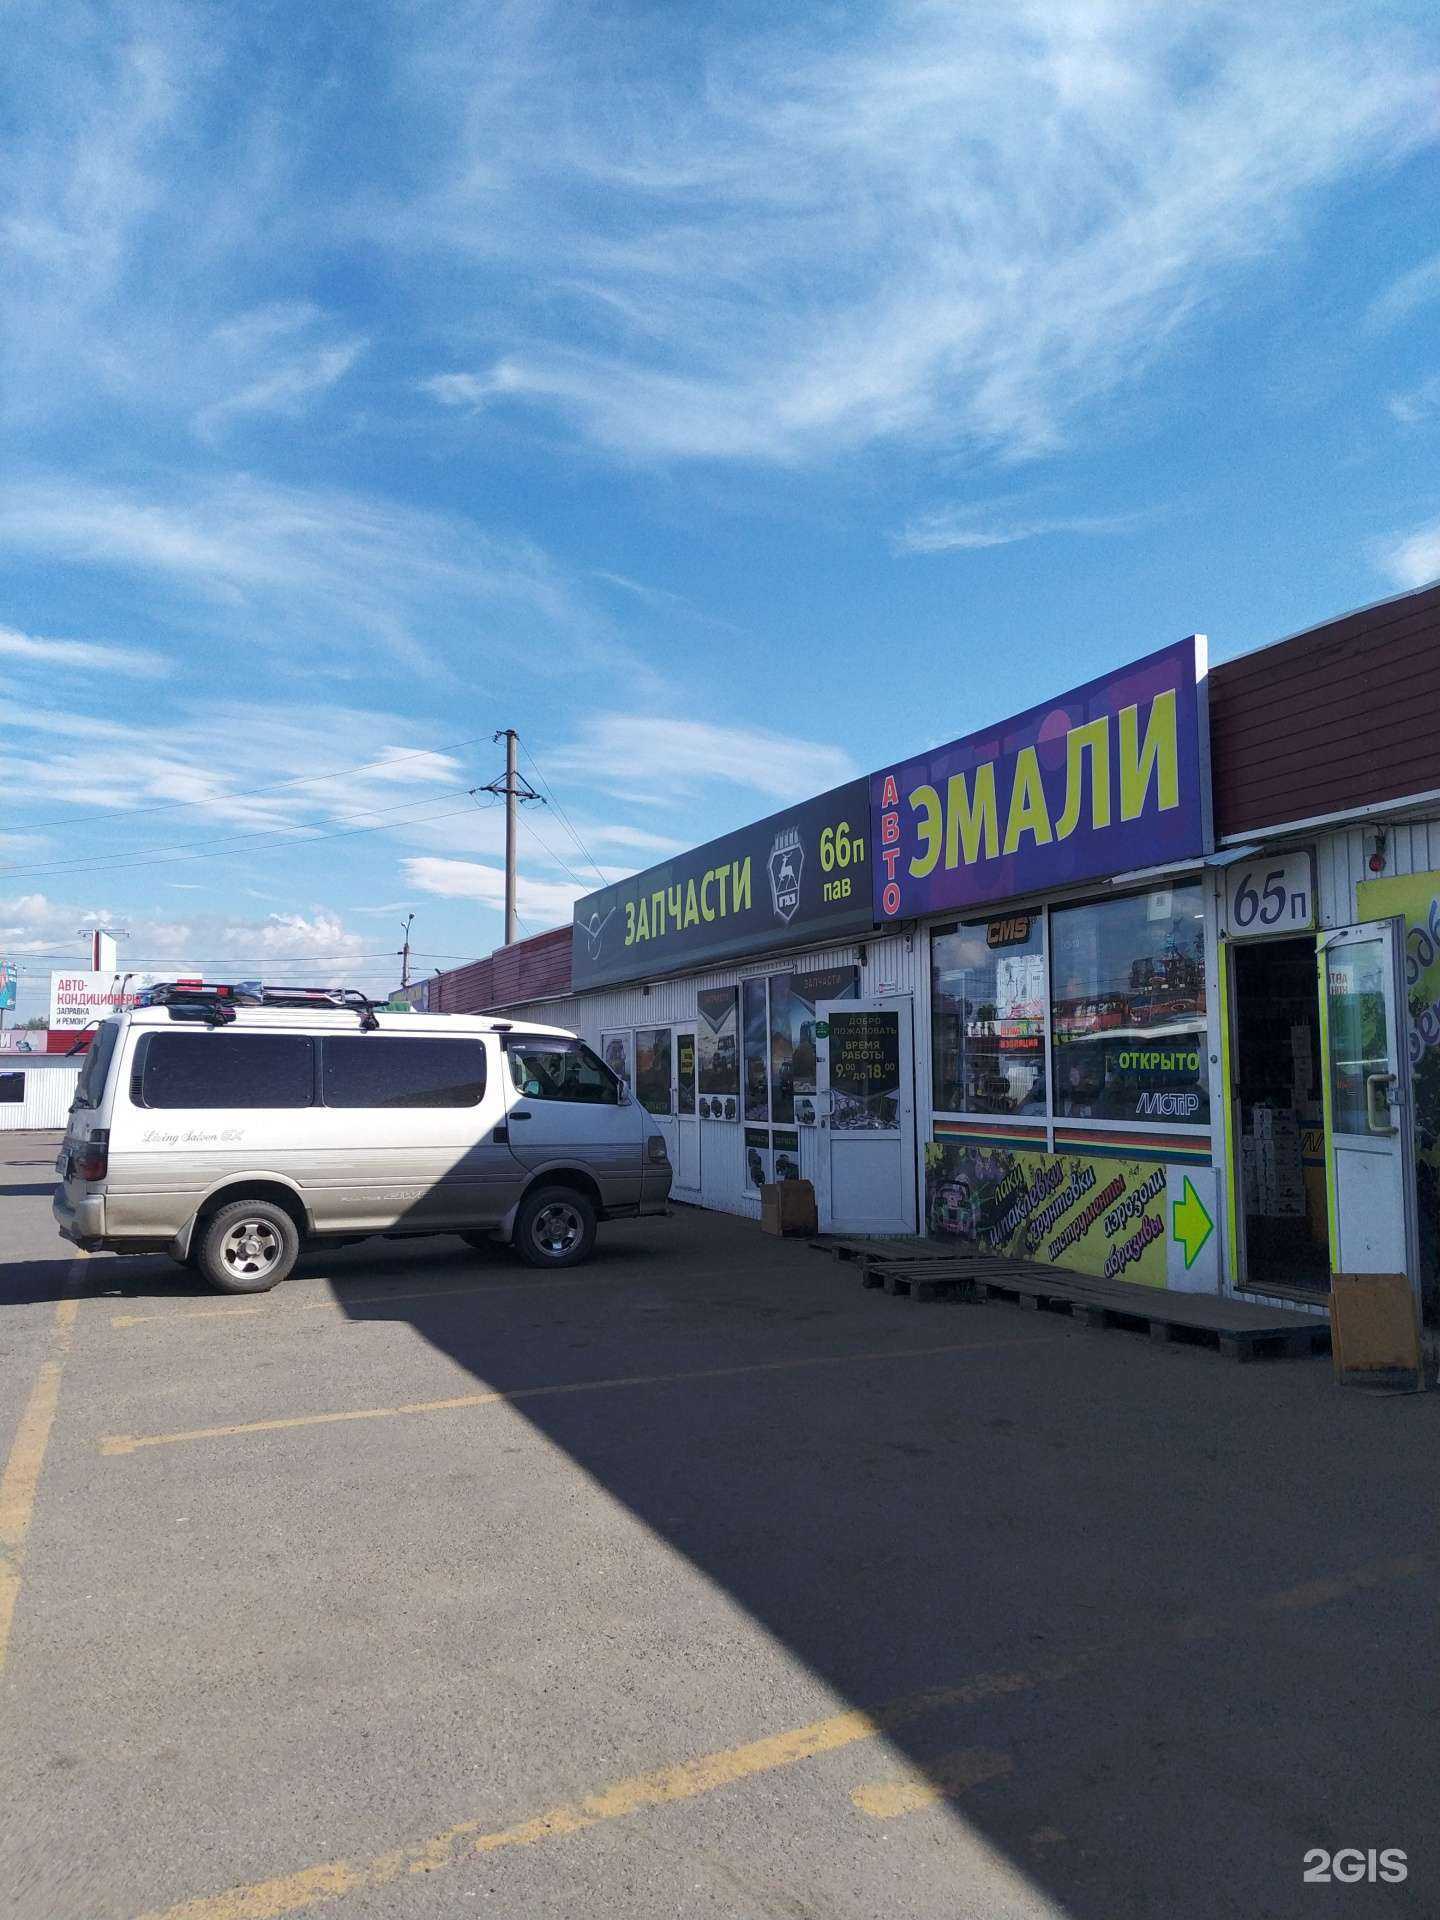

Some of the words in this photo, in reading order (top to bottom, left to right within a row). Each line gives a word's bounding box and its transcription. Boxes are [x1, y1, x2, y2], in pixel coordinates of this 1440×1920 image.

[908, 688, 1179, 879] ЭМАЛИ
[881, 775, 901, 916] АВТО
[624, 856, 752, 946] ЗАПЧАСТИ
[823, 878, 852, 902] пав
[1233, 869, 1307, 927] 65п
[987, 918, 1027, 946] CMS
[58, 979, 88, 991] АВТО-
[57, 1007, 90, 1015] ЗАПРАВКА
[57, 1017, 61, 1025] И
[62, 1017, 87, 1025] РЕМОНТ
[849, 1017, 881, 1025] ДОБРО
[841, 1050, 885, 1060] РАБОТЫ
[846, 1040, 880, 1050] ВРЕМЯ
[1119, 1052, 1199, 1071] ОТКРЫТО
[994, 1162, 1024, 1206] лаки
[1103, 1167, 1167, 1239] аэрозоли
[1048, 1173, 1126, 1262] инструменты
[1104, 1213, 1164, 1279] абразивы
